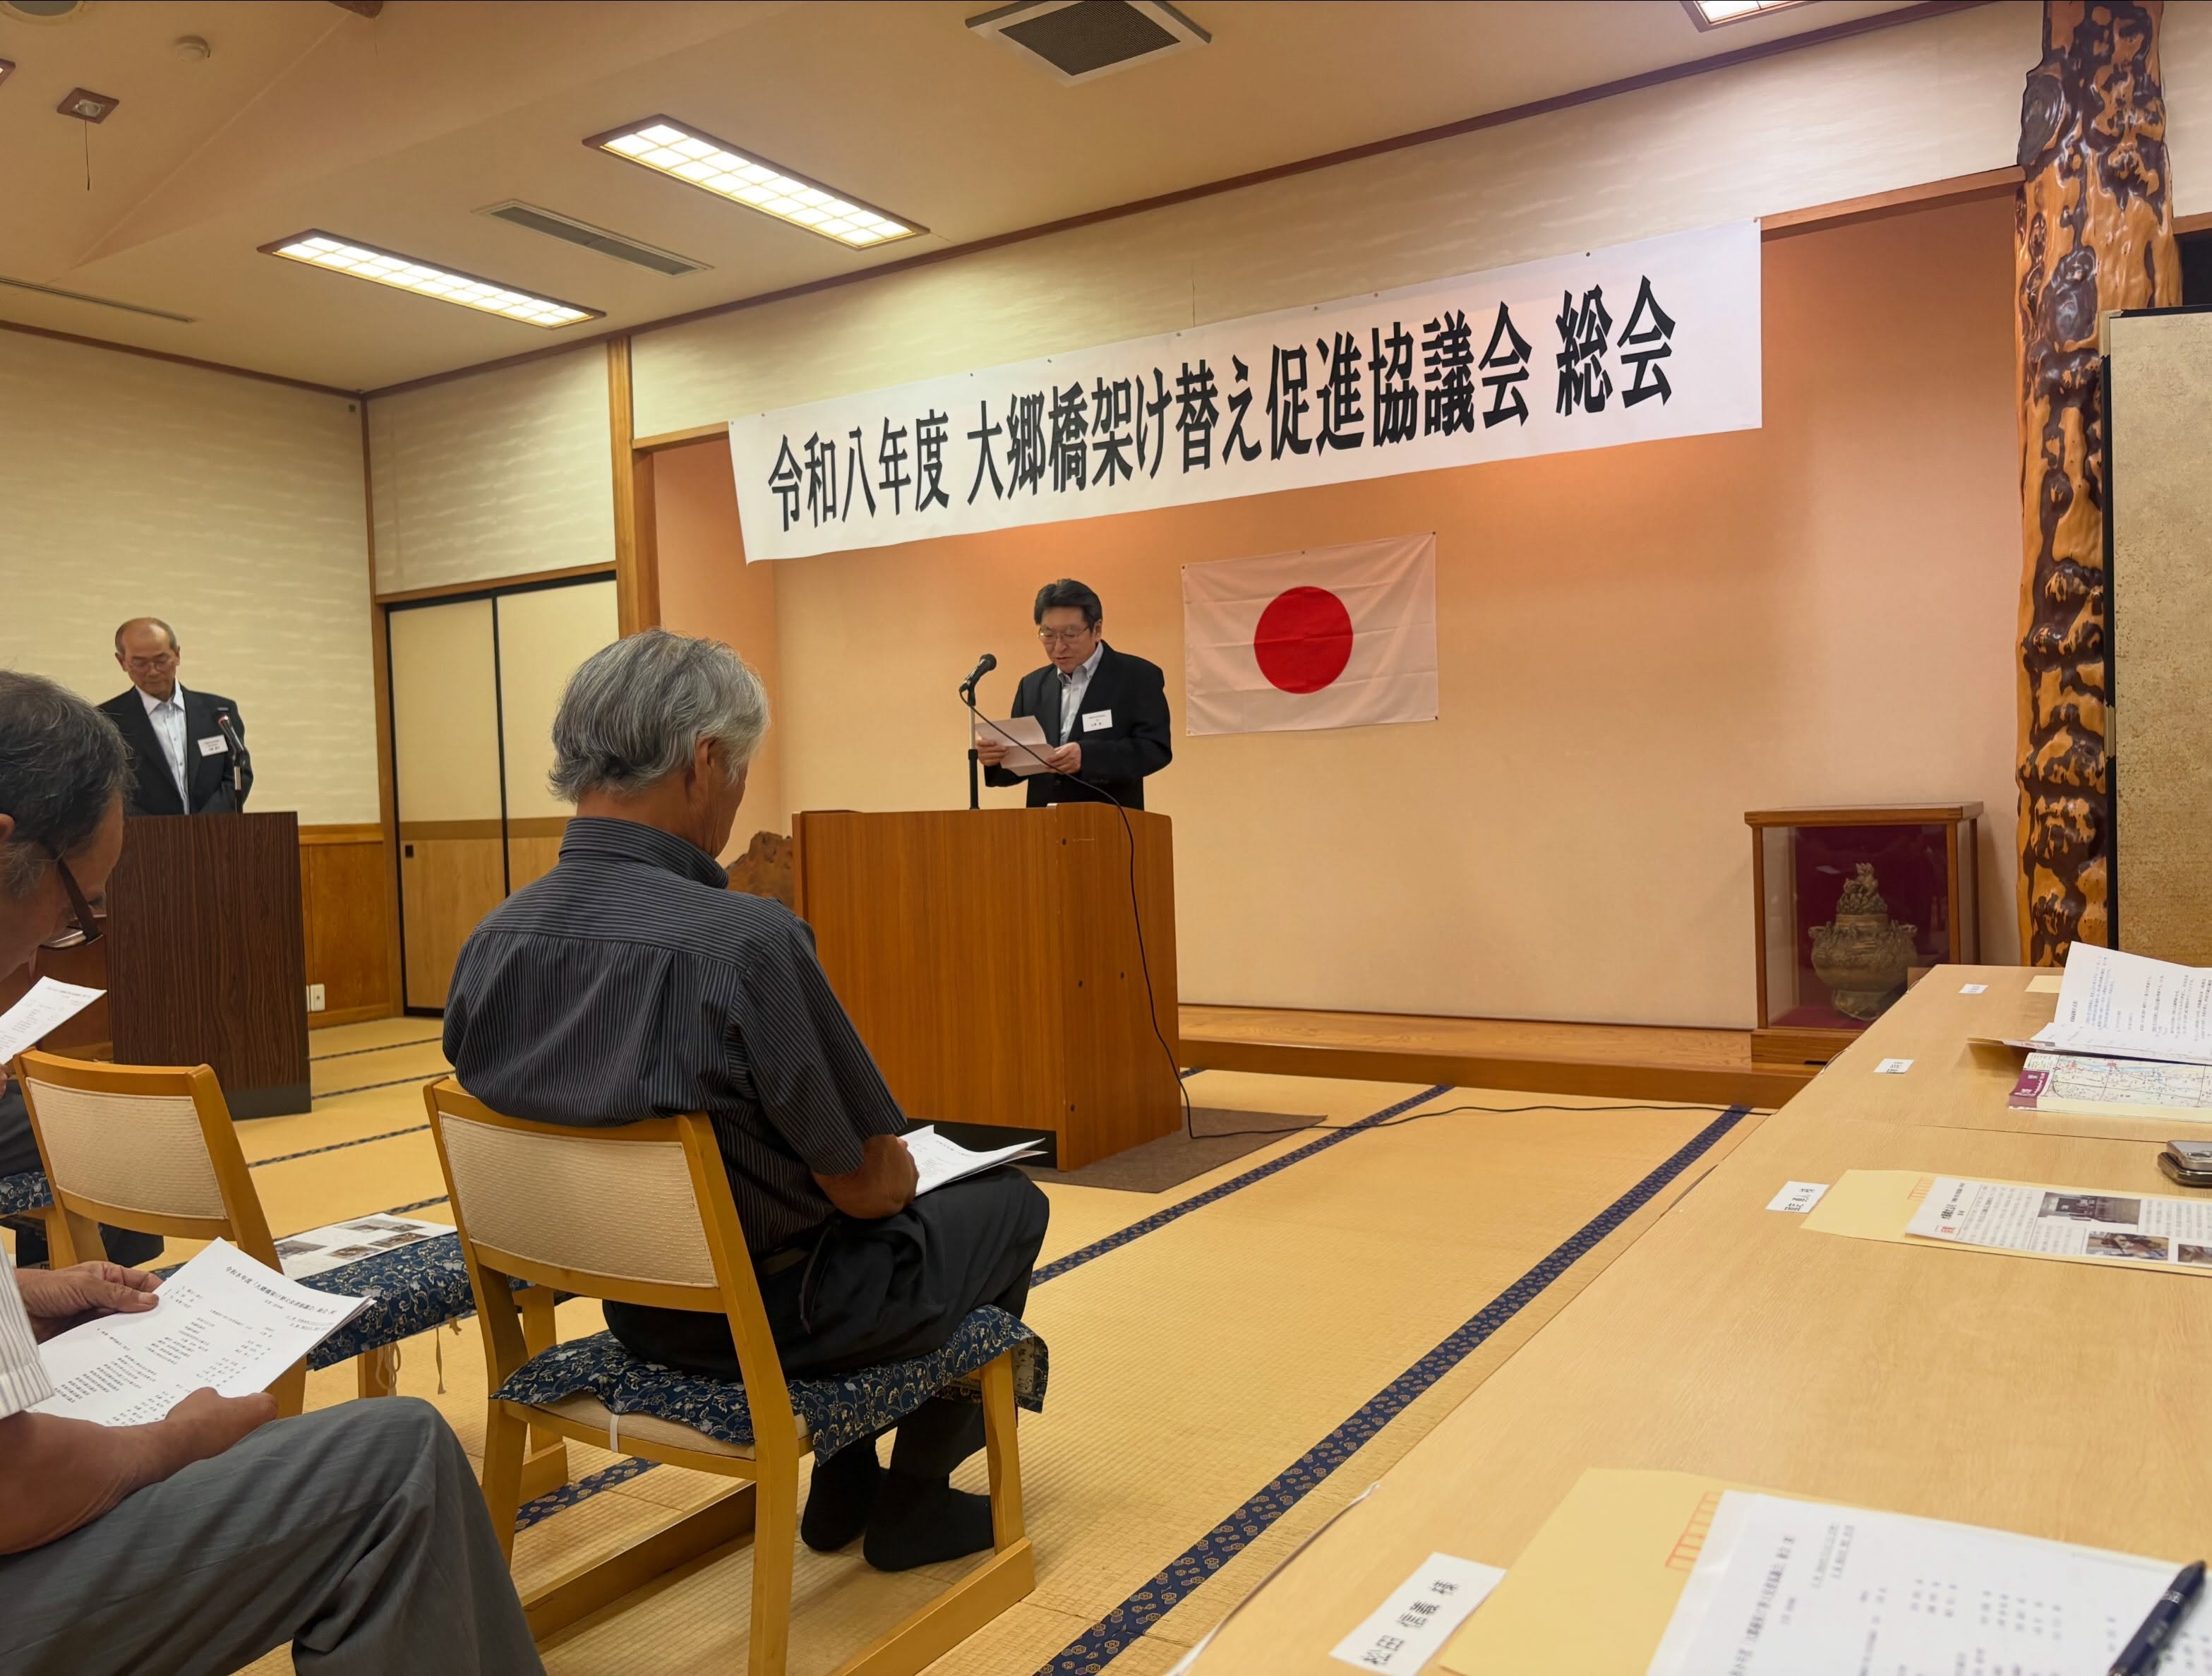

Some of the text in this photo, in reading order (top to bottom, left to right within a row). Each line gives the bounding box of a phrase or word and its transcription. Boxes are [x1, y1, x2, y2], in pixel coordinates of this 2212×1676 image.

[767, 274, 1676, 533] 令和八年度 大郷橋架け替え促進協議会 総会
[1362, 1634, 1405, 1665] 松田
[1429, 1579, 1459, 1596] 様
